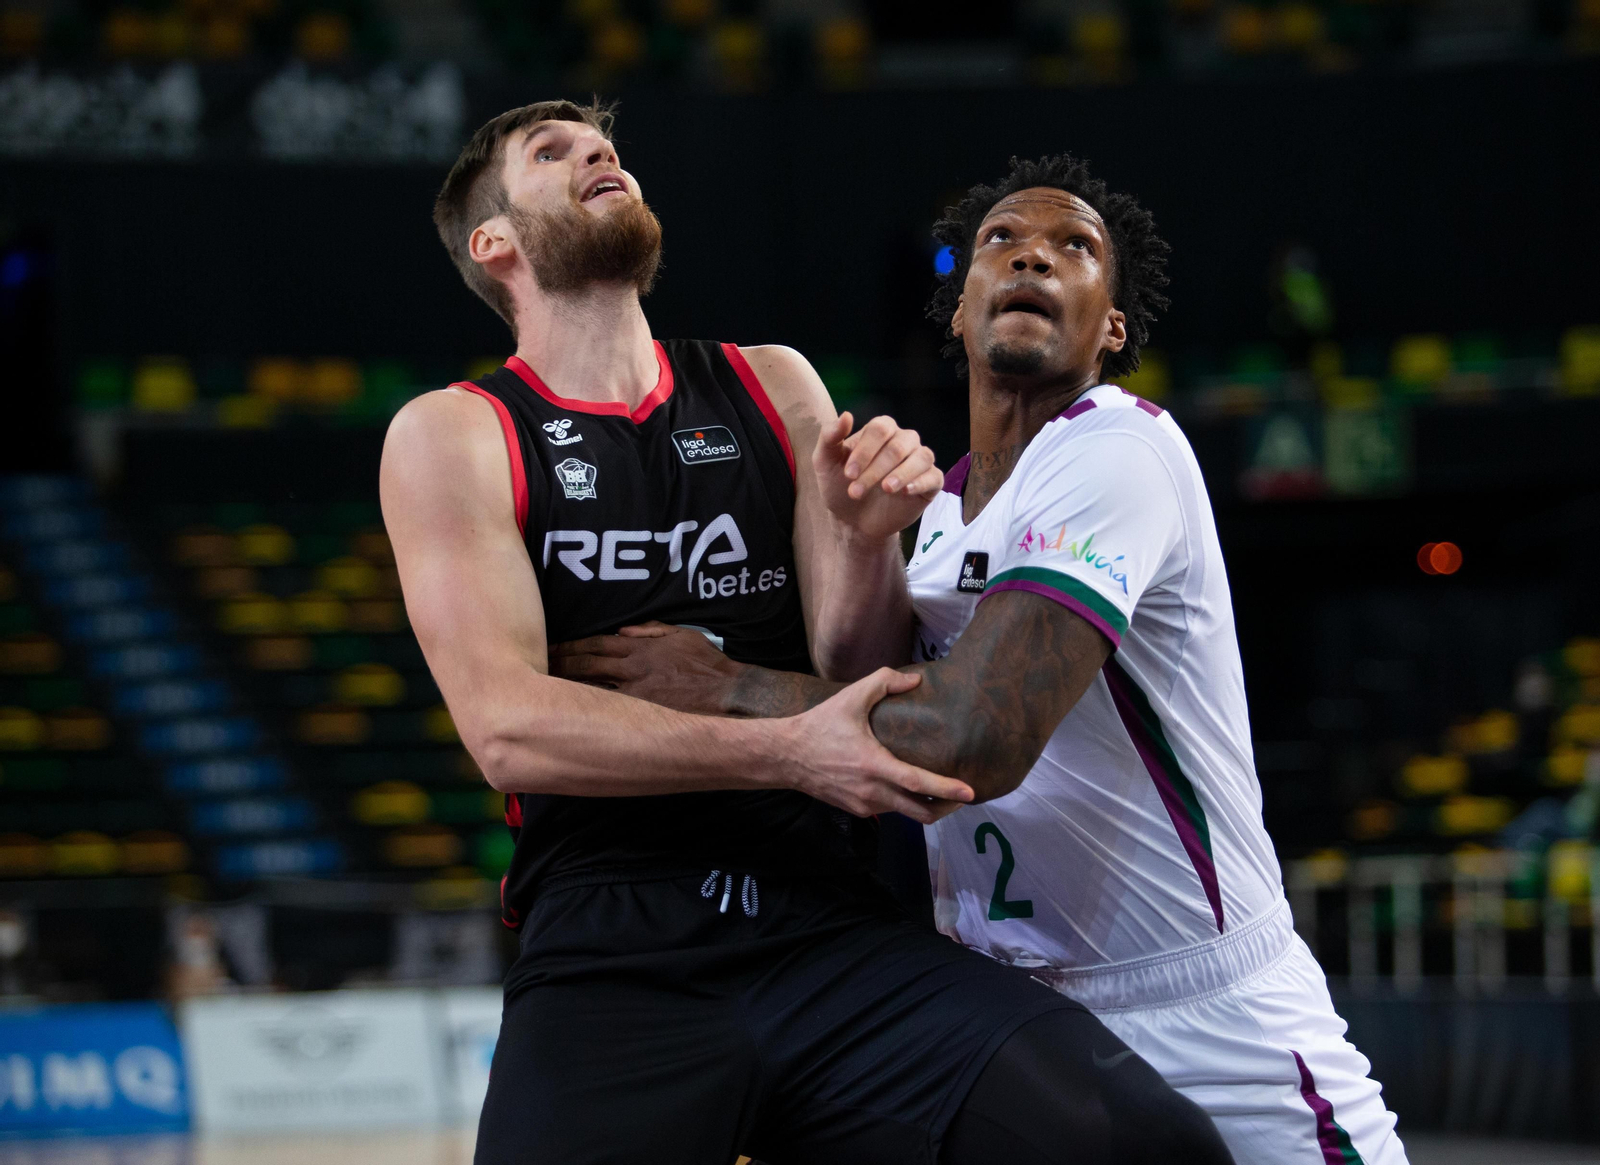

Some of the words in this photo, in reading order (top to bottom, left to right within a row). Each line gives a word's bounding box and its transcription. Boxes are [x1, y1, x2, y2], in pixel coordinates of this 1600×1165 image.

[681, 439, 705, 449] liga
[687, 444, 735, 457] endesa
[543, 513, 748, 593] RETA
[1017, 522, 1129, 597] Andalucía
[699, 566, 787, 599] bet.es
[974, 821, 1034, 921] 2
